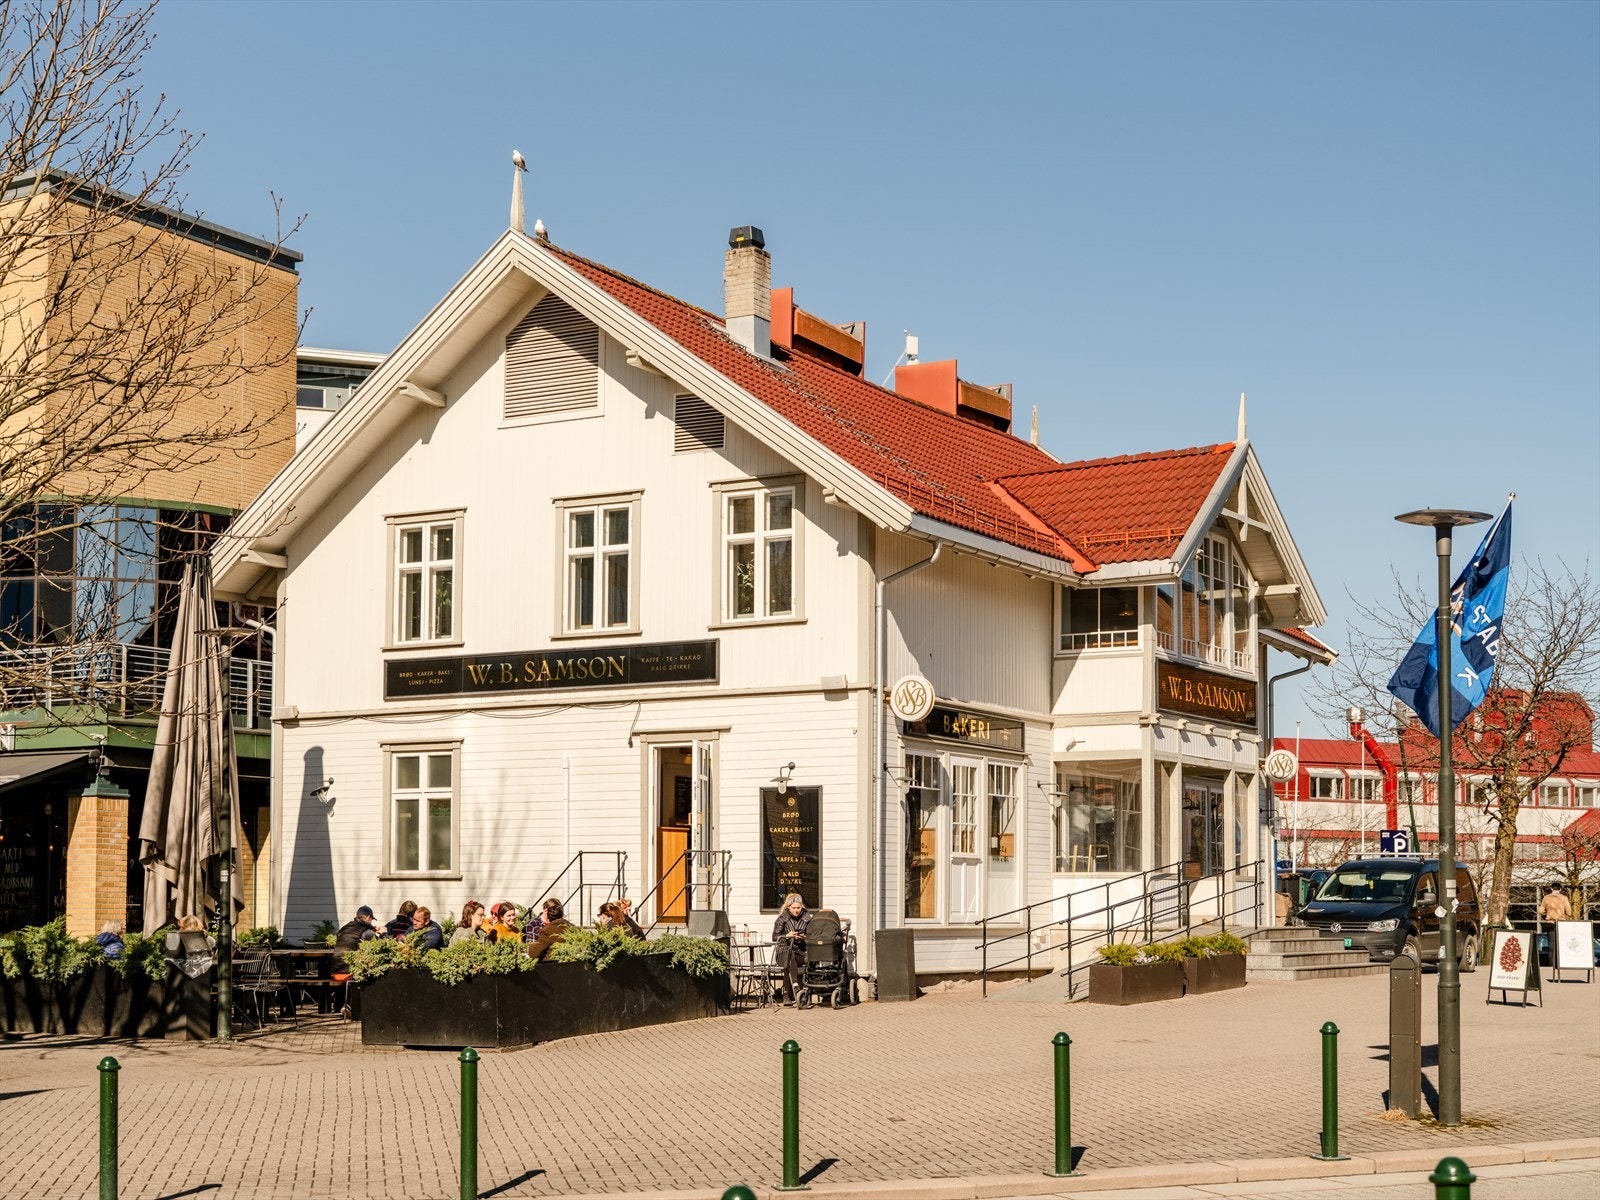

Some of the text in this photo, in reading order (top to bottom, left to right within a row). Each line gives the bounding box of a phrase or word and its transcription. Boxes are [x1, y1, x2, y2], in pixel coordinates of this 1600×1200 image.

[468, 655, 626, 685] W. B. SAMSON
[1168, 675, 1246, 713] W. B. SAMSON
[943, 714, 991, 740] BAKERI
